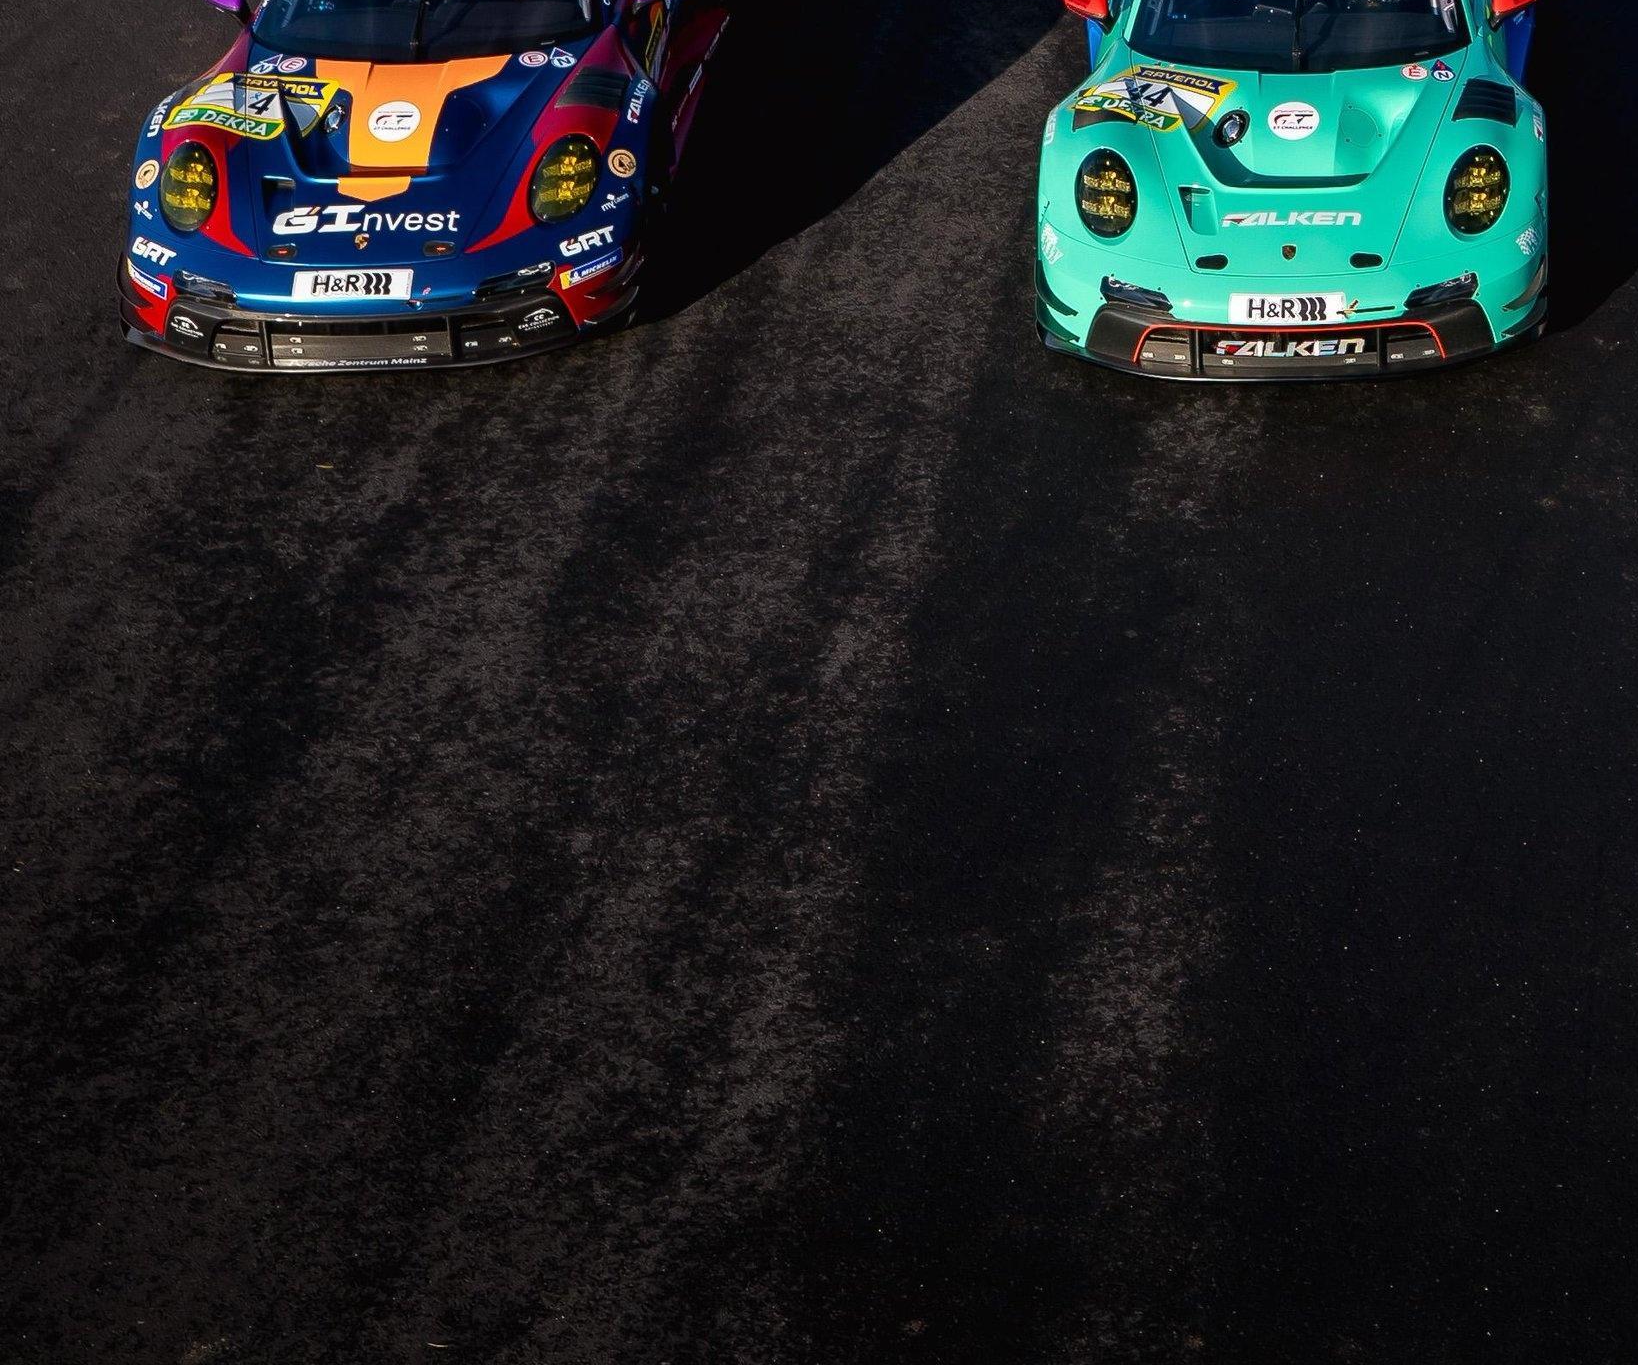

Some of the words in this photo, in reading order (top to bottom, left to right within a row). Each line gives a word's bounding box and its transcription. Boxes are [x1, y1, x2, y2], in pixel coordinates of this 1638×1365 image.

[1141, 69, 1217, 91] RAVENOL
[248, 93, 276, 115] 4
[201, 109, 269, 136] DEKRA
[1221, 211, 1362, 229] FALKEN
[131, 235, 178, 267] GRT
[558, 224, 615, 258] GRT
[311, 273, 361, 296] H&R
[1247, 297, 1297, 320] H&R
[1215, 338, 1365, 358] FALKEN
[390, 356, 428, 366] Mainz
